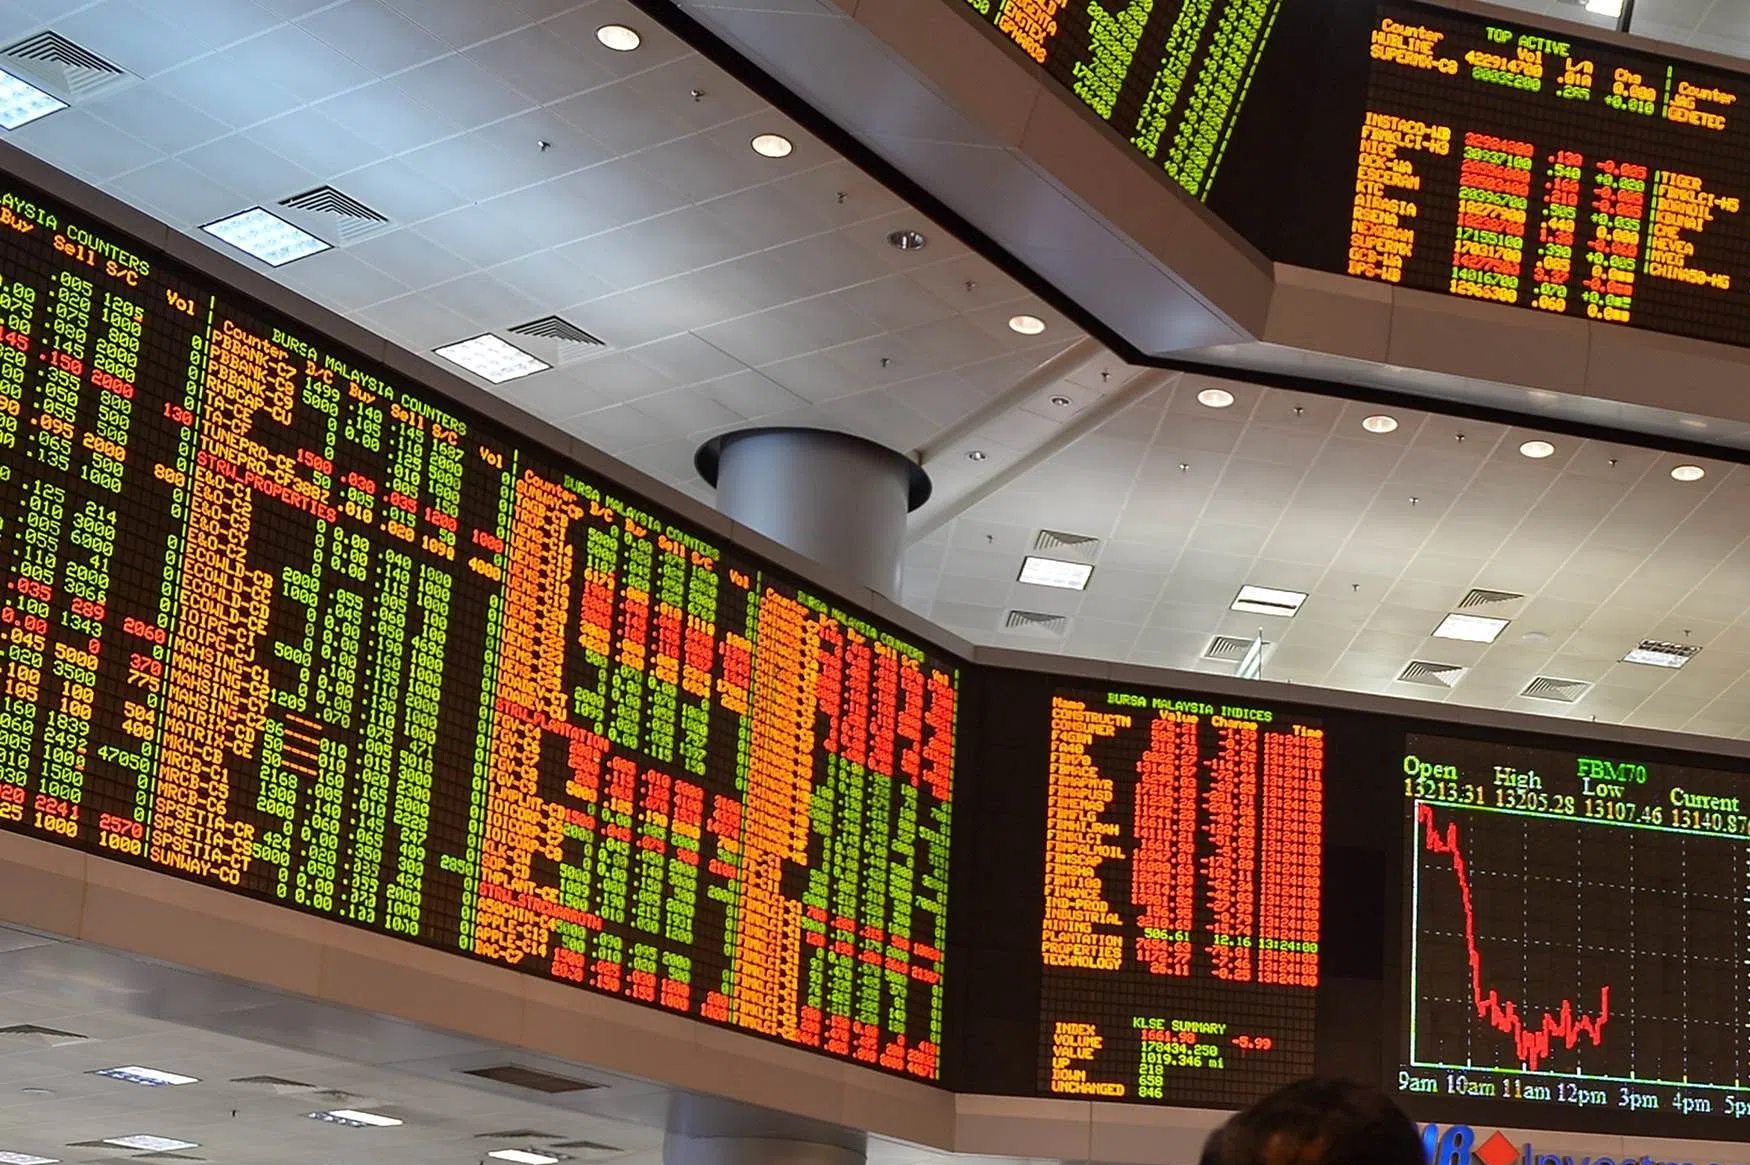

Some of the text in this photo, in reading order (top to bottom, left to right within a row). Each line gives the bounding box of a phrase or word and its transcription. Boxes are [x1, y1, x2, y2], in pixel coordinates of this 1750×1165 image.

[1382, 18, 1444, 42] Counter
[1486, 27, 1571, 57] TOP ACTIVE
[0, 207, 195, 316] Buy Sell S/C Vol
[67, 225, 150, 276] COUNTERS
[50, 287, 141, 337] .020 1000
[51, 272, 144, 322] .005 1205
[210, 345, 338, 417] PBBANK-C8 5000
[212, 330, 340, 401] PBBANK-C7 1499
[206, 375, 292, 425] RHBCAP-CU
[208, 360, 293, 410] PBBANK-C9
[224, 320, 503, 469] Counter B/C Buy Sell Vol
[325, 355, 394, 400] MALAYSIA
[401, 394, 467, 436] COUNTERS
[204, 405, 252, 436] TA-CF
[206, 390, 253, 424] TA-CE
[202, 420, 296, 474] TUNEPRO-CE
[195, 465, 252, 501] E&O-C1
[191, 498, 250, 532] E&O-C3
[184, 558, 318, 607] ECOWLD-CC 1000
[186, 543, 319, 592] ECOWLD-CB 2000
[180, 590, 268, 635] ECOWLD-CE
[182, 574, 269, 620] ECOWLD-CD
[178, 621, 255, 661] IOIPG-CJ
[180, 606, 255, 646] IOIPG-CI
[174, 636, 269, 683] MAHSING-C1
[167, 701, 255, 742] MATRIX-CD
[1107, 692, 1272, 722] BURSA MALAYSIA INDICES
[163, 732, 223, 764] MKH-CB
[165, 716, 253, 759] MATRIX-CE
[159, 764, 229, 798] MRCB-C5
[161, 748, 229, 782] MRCB-C1
[1403, 755, 1740, 813] Open High Low Current
[1576, 758, 1647, 784] FBM70
[157, 780, 227, 815] MRCB-C6
[1404, 779, 1484, 805] 13213.31
[1495, 789, 1575, 816] 13205.28
[1584, 799, 1663, 825] 13107.46
[156, 797, 255, 840] SPSETIA-CR
[150, 847, 240, 885] SUNWAY-CO
[152, 830, 251, 871] SPSETIA-CT
[1045, 885, 1100, 899] FINANCE
[1044, 908, 1123, 925] INDUSTRIAL
[1042, 931, 1123, 947] PLANTATION
[1042, 942, 1121, 958] PROPERTIES
[1043, 920, 1318, 952] MINING 506.61 12.16 13:24:00
[1042, 953, 1122, 970] TECHNOLOGY
[1055, 1022, 1271, 1049] INDEX 1661.98 -5.99
[1133, 1017, 1226, 1034] KLSE SUMMARY
[1053, 1046, 1094, 1060] VALUE
[1141, 1052, 1202, 1067] 1019.346
[1054, 1034, 1217, 1056] VOLUME 178434.250
[1052, 1057, 1163, 1075] UP 218
[1052, 1068, 1163, 1086] DOWN 658
[1051, 1080, 1163, 1098] UNCHANGED 846
[1398, 1070, 1437, 1093] 9am
[1445, 1075, 1496, 1097] 10am
[1502, 1078, 1551, 1101] 11am
[1557, 1084, 1607, 1106] 12pm
[1618, 1087, 1659, 1109] 3pm
[1672, 1091, 1711, 1114] 4pm
